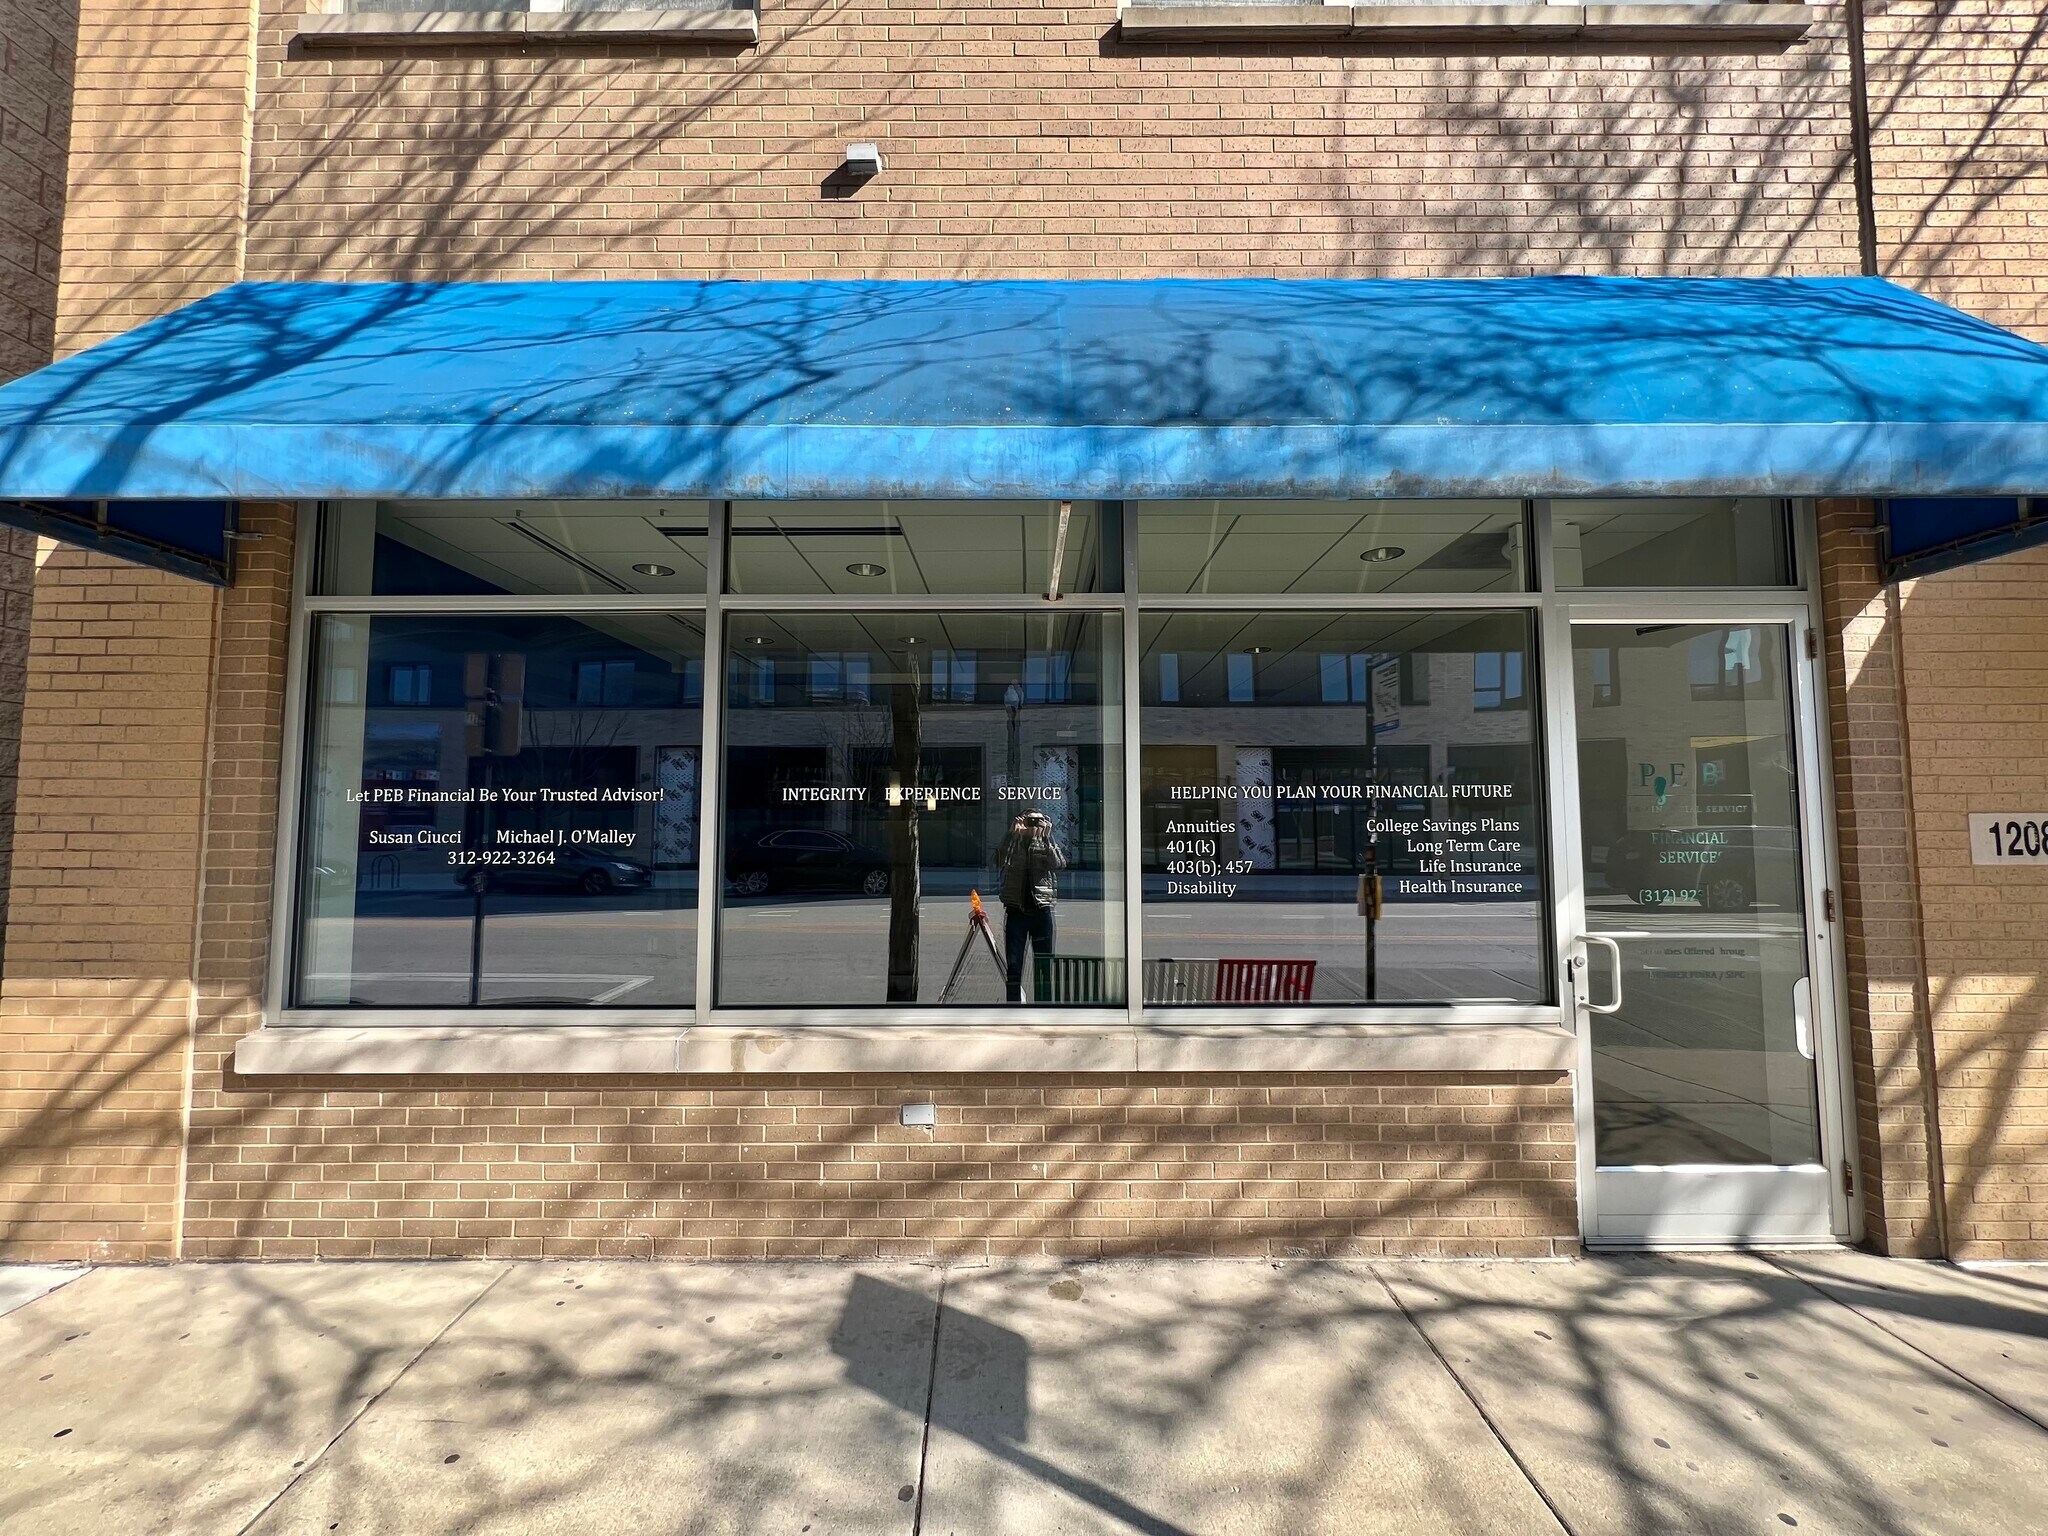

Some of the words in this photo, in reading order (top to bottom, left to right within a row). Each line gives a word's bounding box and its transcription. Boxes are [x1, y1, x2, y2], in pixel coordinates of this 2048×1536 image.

[346, 788, 370, 802] Let
[373, 788, 404, 802] PEB
[408, 787, 475, 802] Financial
[479, 788, 498, 802] Be
[502, 788, 537, 802] Your
[540, 787, 598, 802] Trusted
[601, 787, 664, 802] Advisor!
[782, 787, 867, 801] INTEGRITY
[884, 787, 981, 801] EXPERIENCE
[998, 786, 1061, 800] SERVICE
[1170, 786, 1238, 800] HELPING
[1241, 785, 1272, 799] YOU
[1276, 785, 1316, 799] PLAN
[1320, 785, 1363, 799] YOUR
[1366, 784, 1449, 799] FINANCIAL
[1452, 784, 1513, 798] FUTURE
[1165, 819, 1236, 833] Annuities
[1366, 818, 1419, 836] College
[1422, 818, 1477, 835] Savings
[1481, 818, 1520, 832] Plans
[369, 830, 413, 844] Susan
[417, 830, 462, 844] Ciucci
[496, 829, 554, 844] Michael
[557, 830, 567, 846] J.
[571, 829, 637, 847] O’Malley
[1651, 831, 1729, 845] FINANCIAL
[1166, 839, 1216, 856] 401(k)
[1407, 839, 1443, 855] Long
[1446, 839, 1484, 852] Term
[1488, 839, 1521, 852] Care
[447, 850, 556, 865] 312-922-3264
[1166, 860, 1222, 877] 403(b);
[1225, 860, 1254, 874] 457
[1419, 858, 1447, 873] Life
[1450, 859, 1522, 873] Insurance
[1167, 880, 1237, 898] Disability
[1399, 879, 1447, 894] Health
[1451, 879, 1523, 893] Insurance
[1639, 888, 1676, 906] (312)
